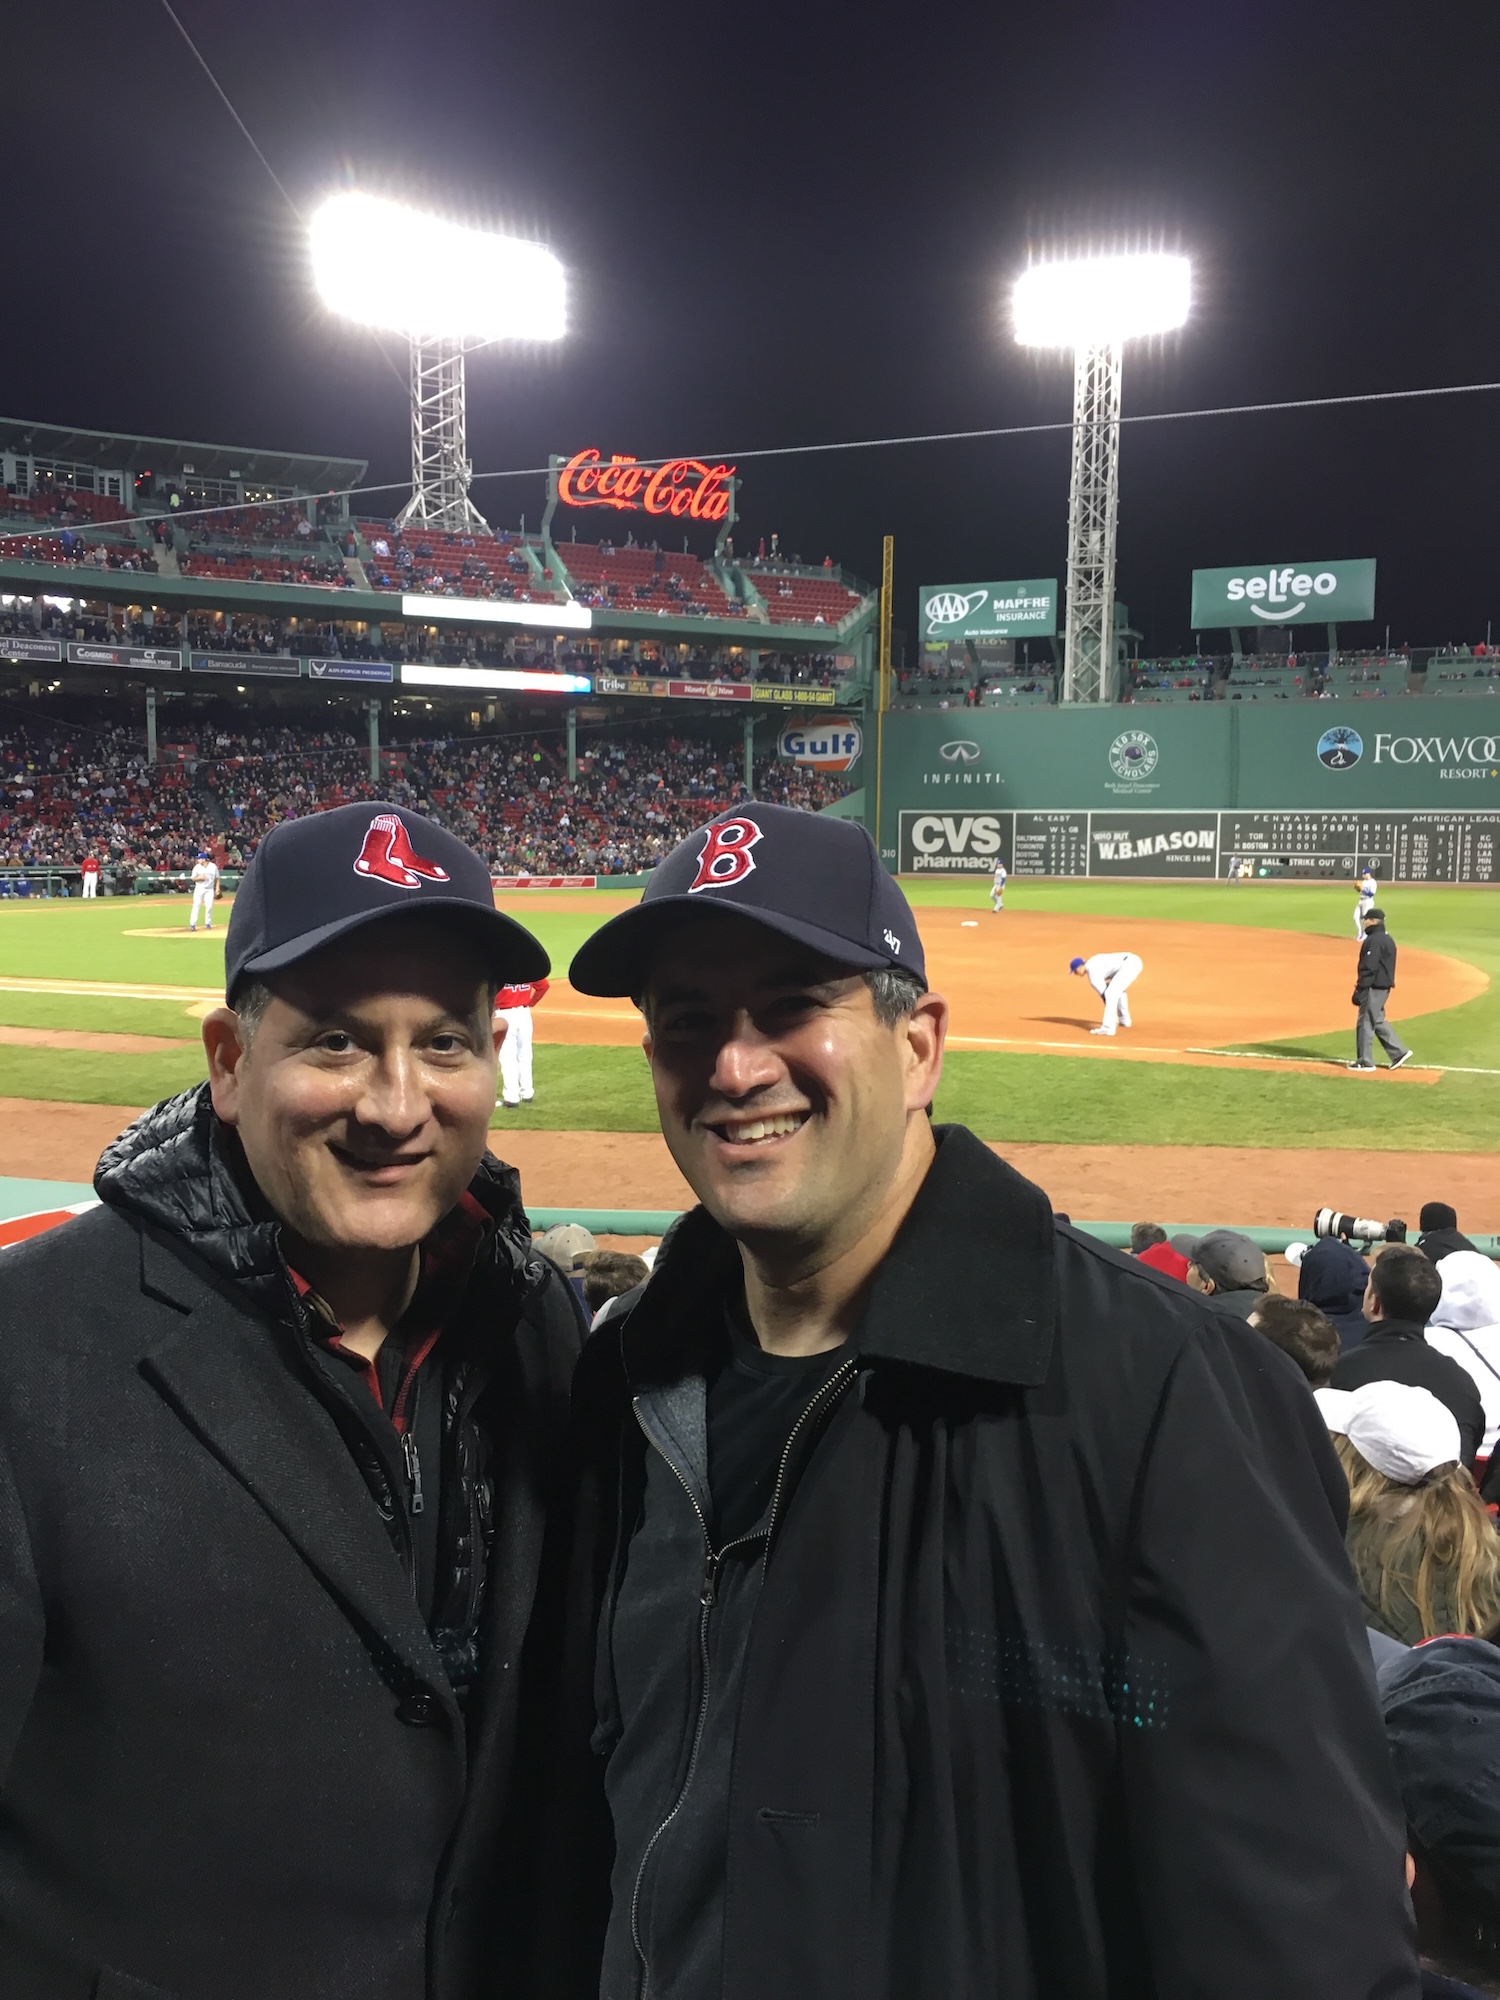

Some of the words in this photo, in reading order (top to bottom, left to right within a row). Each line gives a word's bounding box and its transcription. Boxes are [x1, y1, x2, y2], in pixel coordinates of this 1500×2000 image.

[612, 455, 636, 464] ENJOY
[557, 449, 736, 521] Coca-Cola
[931, 594, 964, 622] AAA
[993, 597, 1050, 610] MAPFRE
[996, 610, 1047, 622] INSURANCE
[980, 628, 1008, 636] Insurance
[12, 640, 56, 651] Deaconess
[1, 648, 29, 657] Center
[208, 659, 246, 669] Barracuda
[599, 678, 625, 692] Tribe
[684, 685, 706, 694] Ninety
[718, 687, 734, 695] Nine
[755, 688, 773, 699] GIANT
[773, 690, 793, 701] GLASS
[816, 692, 833, 702] GIANT
[784, 733, 856, 755] Gulf
[1111, 736, 1128, 755] RED
[1131, 732, 1150, 746] SOX
[1113, 750, 1156, 777] SCHOLARS
[1440, 768, 1488, 779] RESORT
[923, 773, 1001, 784] INFINITI
[1412, 815, 1465, 823] AMERICAN
[1346, 823, 1355, 832] 10
[1436, 824, 1445, 832] IN
[912, 816, 1001, 854] CVS
[1016, 834, 1048, 842] BALTIMORE
[1093, 832, 1112, 841] WHO
[1113, 832, 1129, 840] BUT
[1480, 834, 1492, 842] KC
[1016, 843, 1045, 851] TORONTO
[1242, 842, 1269, 850] BOSTON
[1414, 841, 1429, 849] TEX
[688, 817, 765, 894] B
[881, 849, 896, 859] 310
[1015, 851, 1040, 859] BOSTON
[1413, 849, 1429, 857] DET
[1477, 850, 1493, 858] LAA
[913, 853, 999, 872] pharmacy
[1242, 858, 1256, 866] BAT
[1289, 858, 1316, 867] STRIKE
[1318, 858, 1336, 867] OUT
[1477, 857, 1493, 865] MIN
[1412, 864, 1428, 872] SEA
[1475, 865, 1493, 873] CWS
[1411, 872, 1428, 880] NYY
[1479, 873, 1489, 881] TB
